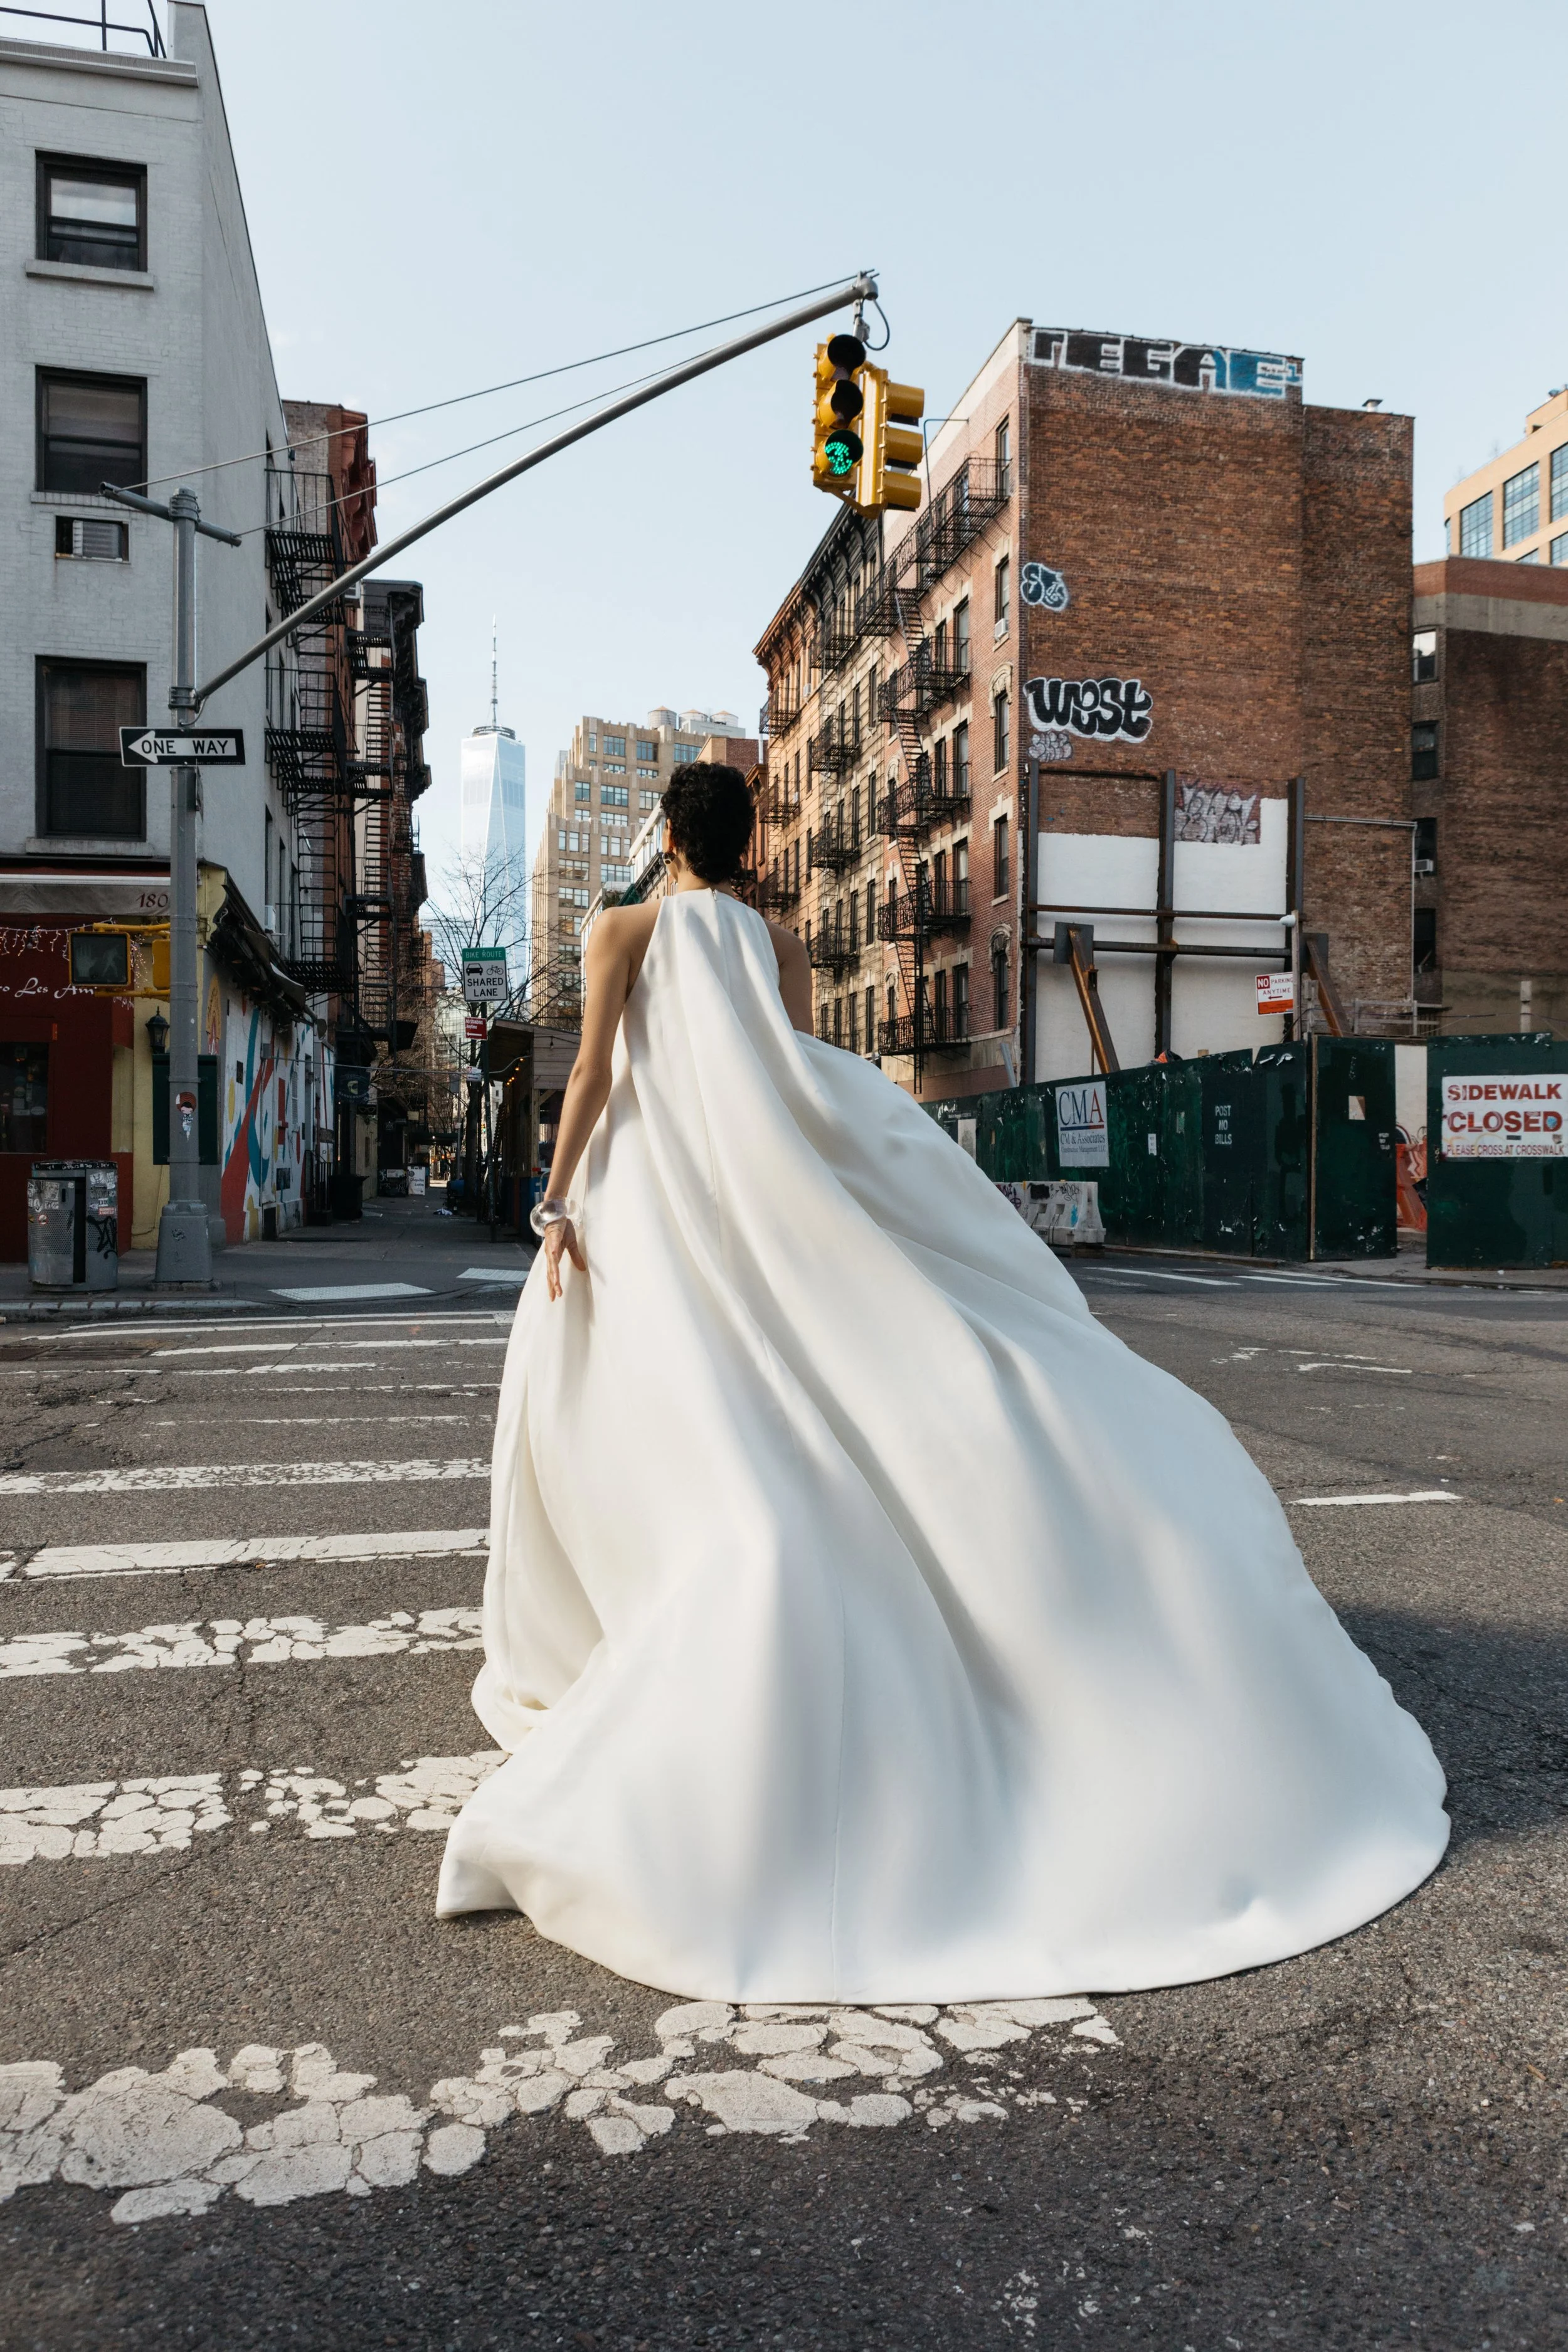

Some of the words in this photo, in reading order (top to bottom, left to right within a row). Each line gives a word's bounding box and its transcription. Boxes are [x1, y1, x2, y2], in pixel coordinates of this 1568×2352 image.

[141, 740, 176, 754] ONE
[193, 740, 228, 754] WAY
[136, 893, 168, 908] 180
[14, 977, 48, 997] Les
[54, 983, 97, 999] Am
[467, 977, 504, 987] SHARED
[1258, 978, 1269, 988] NO
[474, 988, 498, 997] LANE
[1448, 1083, 1562, 1101] SIDEWALK
[1059, 1088, 1104, 1125] CMA
[1215, 1105, 1231, 1116] POST
[1219, 1120, 1228, 1130] NO
[1448, 1111, 1562, 1132] CLOSED
[1061, 1133, 1070, 1145] CM
[1071, 1134, 1076, 1144] &
[1078, 1132, 1106, 1144] Associates
[1215, 1134, 1232, 1145] BILLS
[1447, 1145, 1475, 1155] PLEASE
[1478, 1145, 1503, 1155] CROSS
[1505, 1145, 1514, 1155] AT
[1517, 1145, 1565, 1155] CROSSWALK
